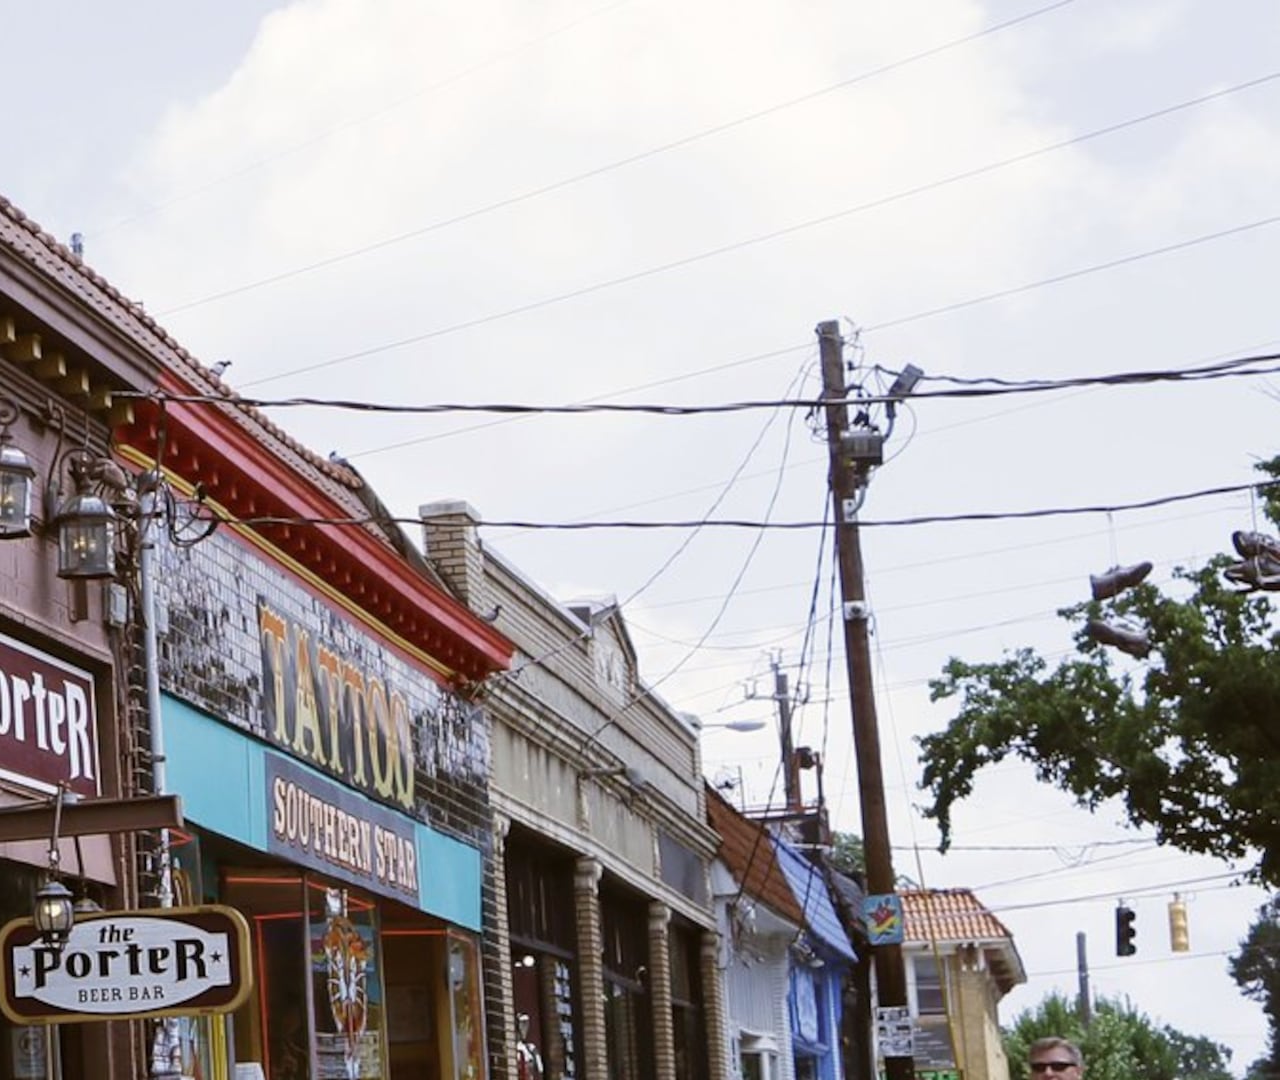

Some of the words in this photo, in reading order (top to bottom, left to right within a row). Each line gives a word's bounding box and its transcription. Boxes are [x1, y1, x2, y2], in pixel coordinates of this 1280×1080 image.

[260, 604, 415, 809] TATTOO
[274, 777, 372, 875] SOUTHERN
[375, 824, 418, 892] STAR
[99, 925, 134, 943] the
[78, 987, 122, 1003] BEER
[129, 985, 165, 1000] BAR
